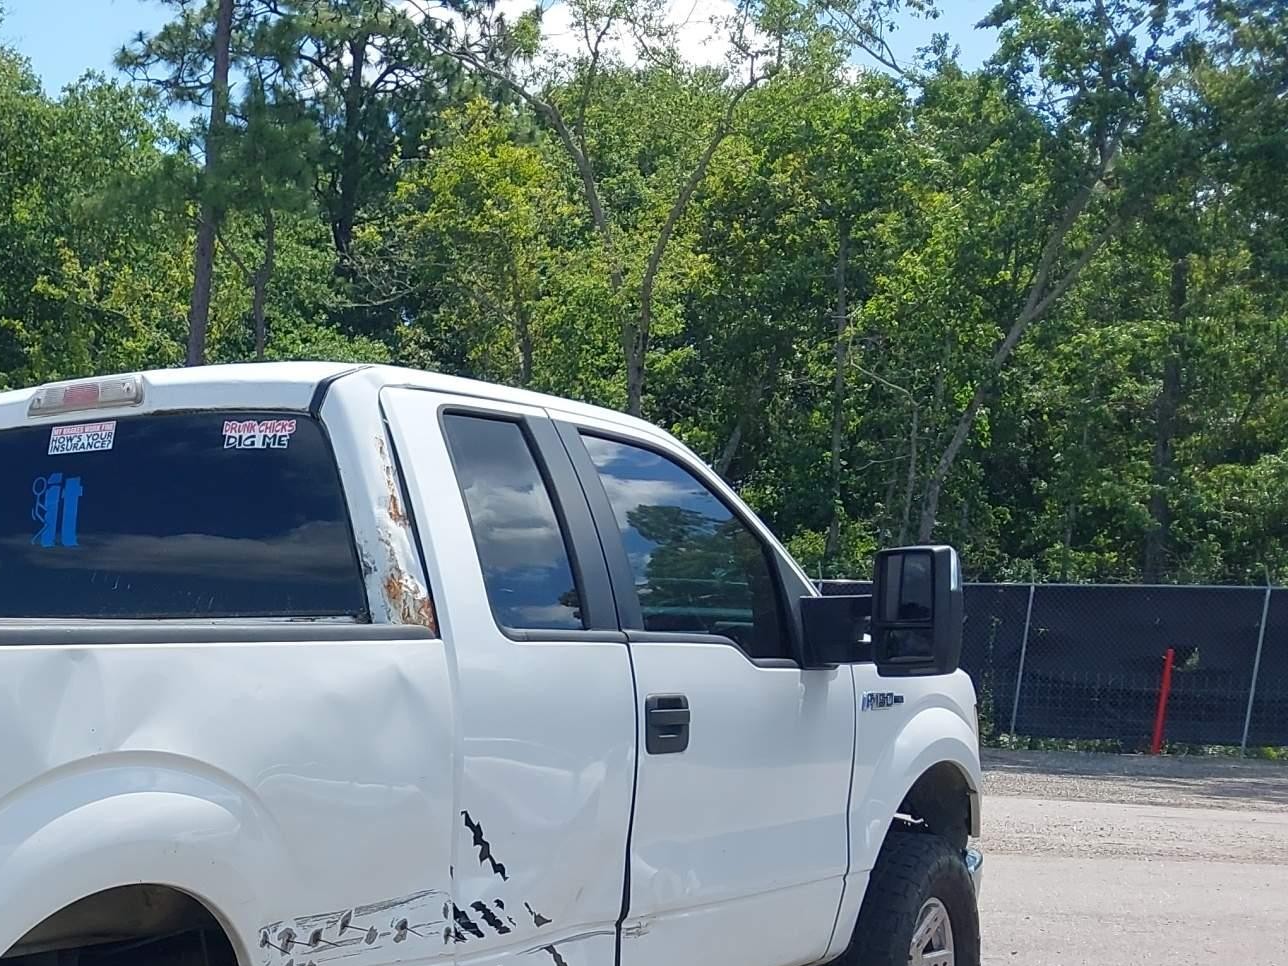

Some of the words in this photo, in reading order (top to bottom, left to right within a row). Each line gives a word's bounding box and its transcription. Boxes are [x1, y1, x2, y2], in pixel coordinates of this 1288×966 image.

[224, 421, 257, 434] DRUNK
[258, 420, 296, 434] CHICKS
[51, 434, 83, 445] HOW'S
[85, 431, 113, 442] YOUR
[225, 434, 256, 447] DIG
[261, 434, 289, 447] ME
[50, 440, 112, 453] INSURANCE?
